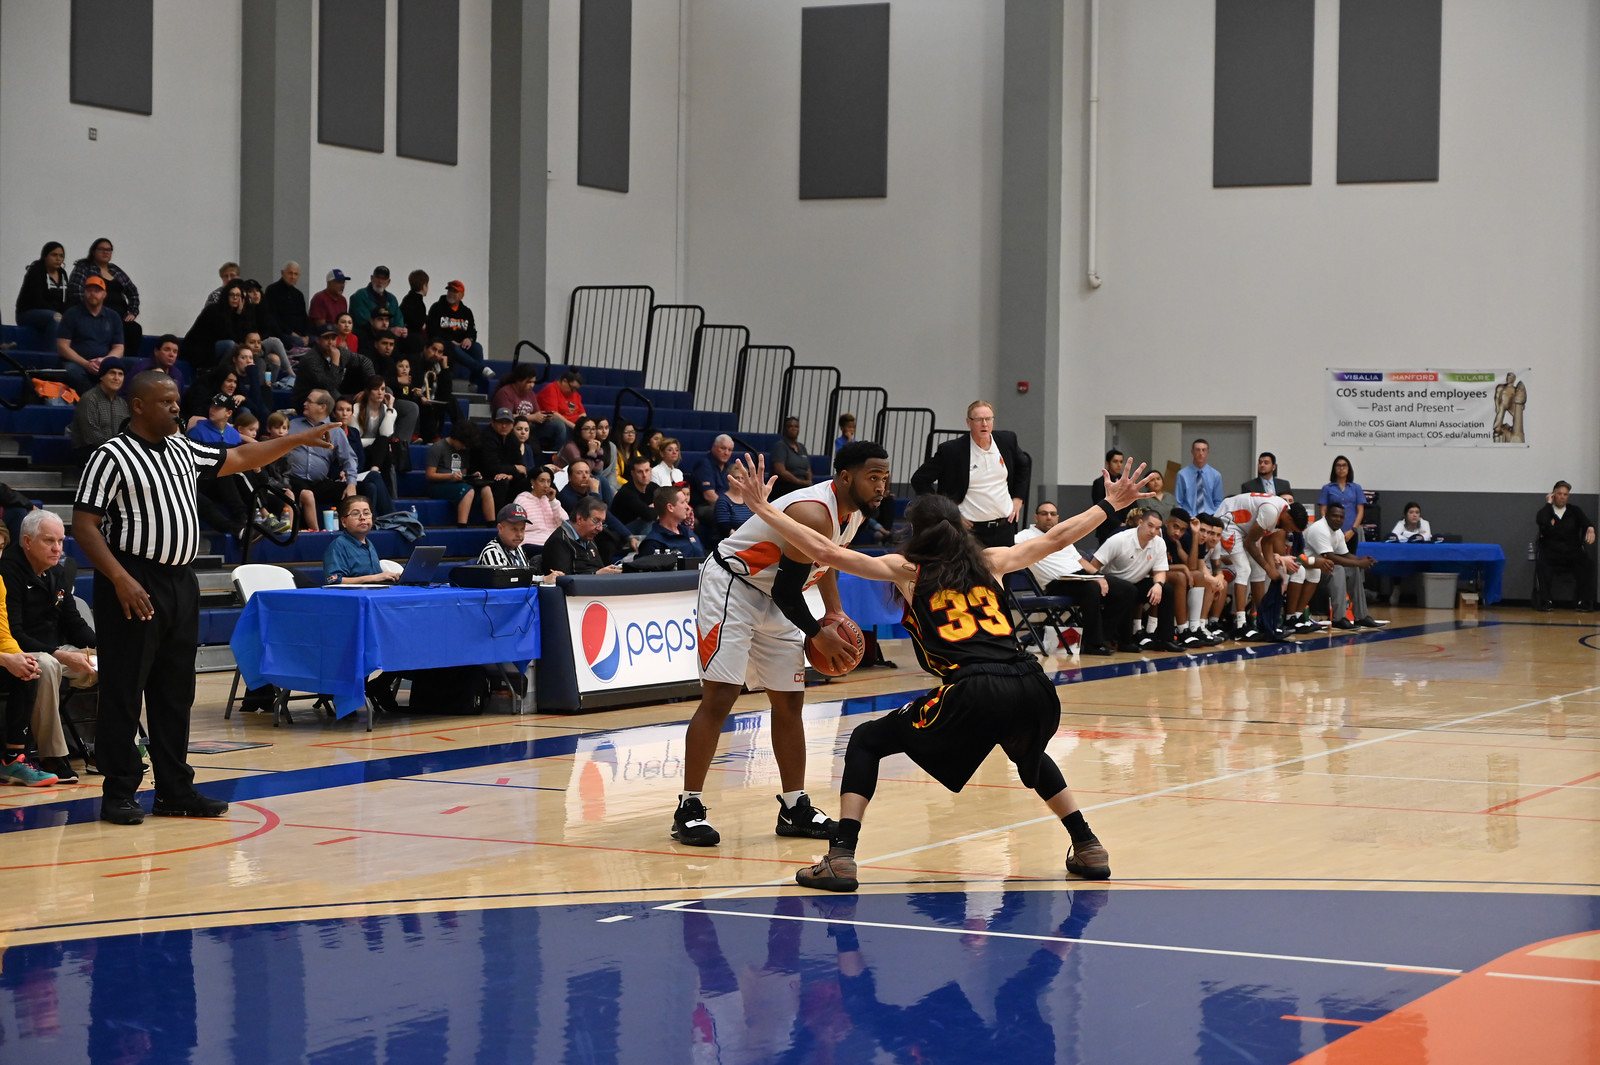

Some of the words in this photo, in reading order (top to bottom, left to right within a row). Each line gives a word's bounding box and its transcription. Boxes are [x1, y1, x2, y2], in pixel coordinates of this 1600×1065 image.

[1336, 388, 1358, 398] COS
[1360, 388, 1405, 398] students
[1408, 389, 1427, 398] and
[1430, 389, 1487, 400] employees
[1372, 403, 1392, 412] Past
[1395, 403, 1414, 412] and
[1416, 403, 1454, 412] Present
[929, 586, 1013, 642] 33
